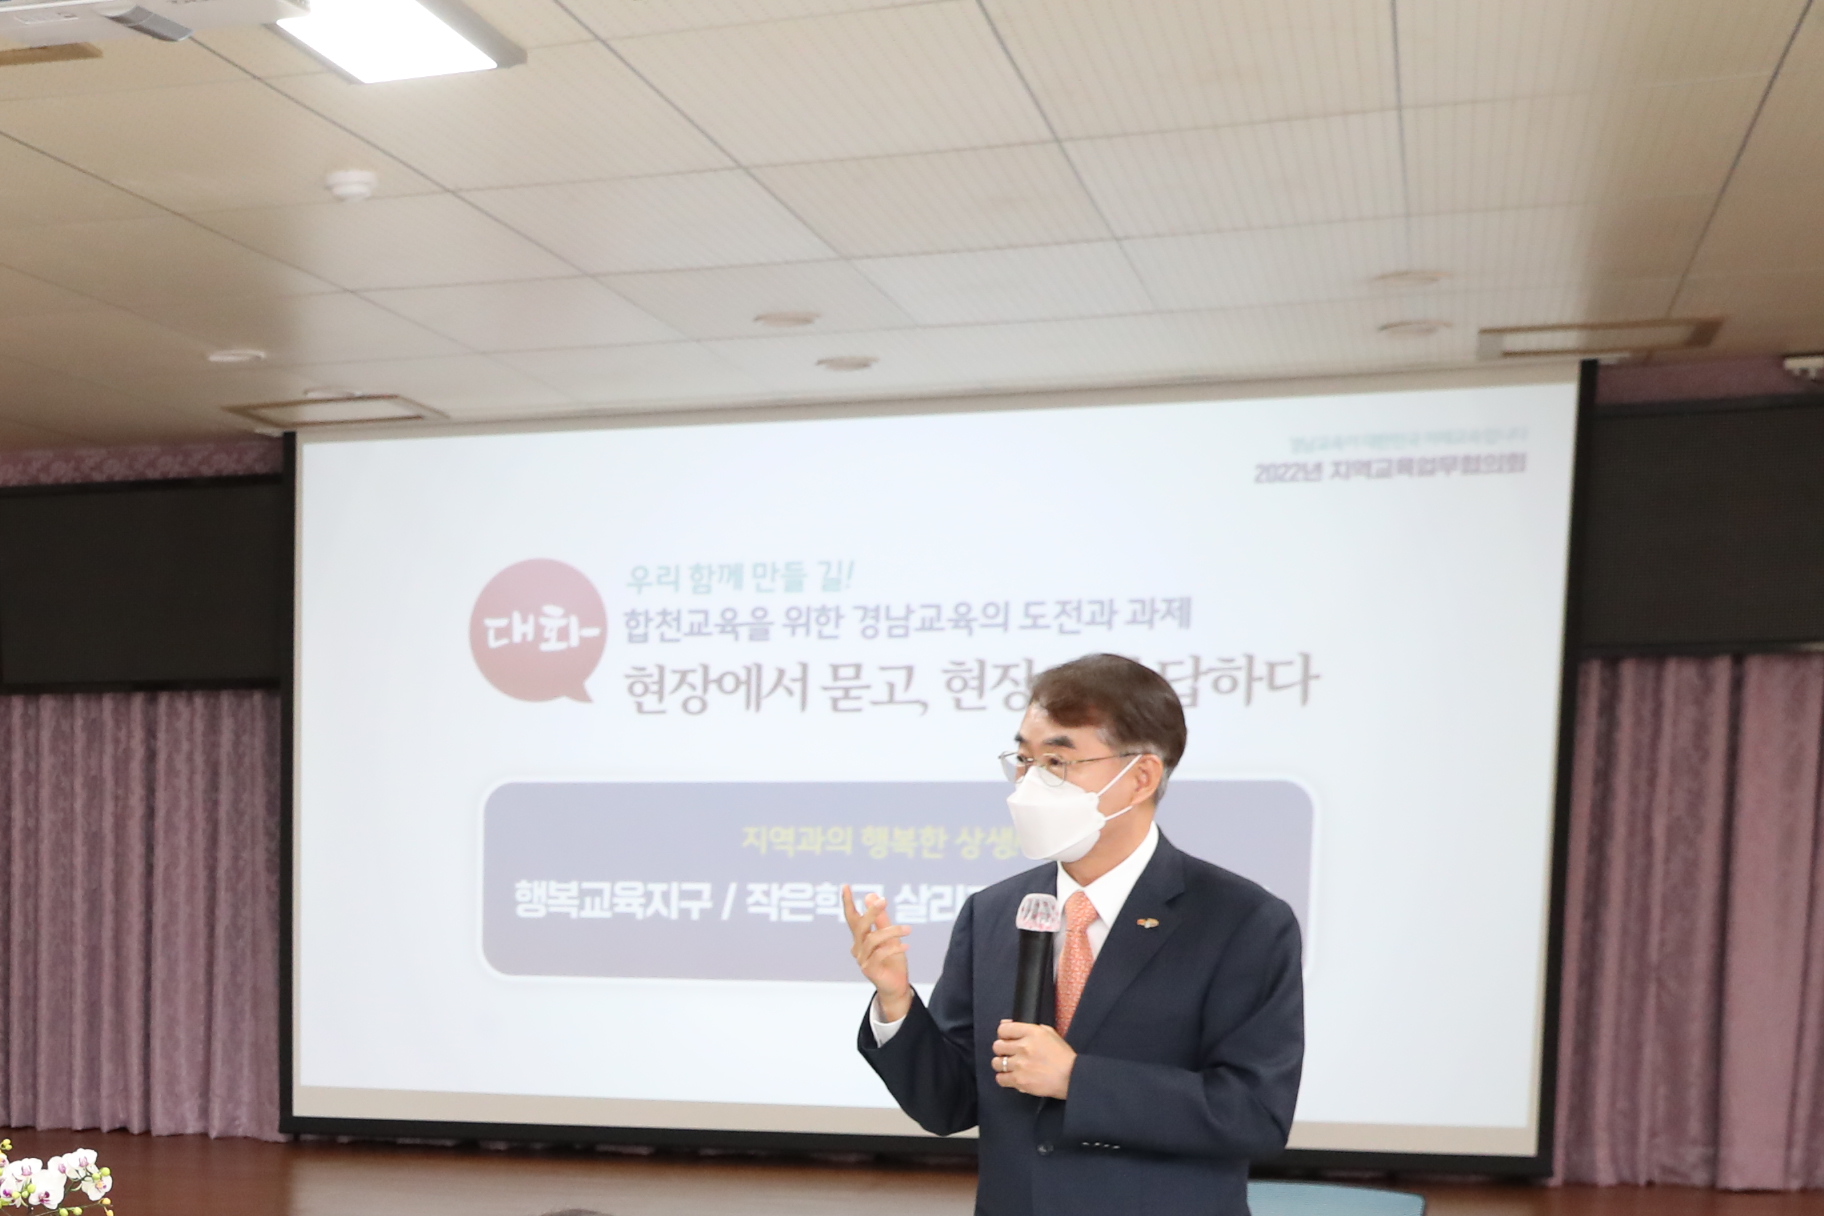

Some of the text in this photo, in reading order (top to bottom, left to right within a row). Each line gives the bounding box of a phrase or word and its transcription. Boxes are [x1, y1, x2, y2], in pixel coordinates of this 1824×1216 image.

[1254, 461, 1323, 483] 2022년
[627, 559, 855, 595] 우리 함께 만들 길!
[484, 604, 601, 652] 대화
[623, 596, 1193, 643] 합천교육을 위한 경남교육의 도전과 과제
[624, 660, 809, 715] 현장에서
[821, 662, 929, 716] 묻고,
[741, 825, 854, 857] 지역과의
[860, 824, 950, 860] 행복한
[514, 881, 713, 920] 행복교육지구
[721, 882, 737, 920] /
